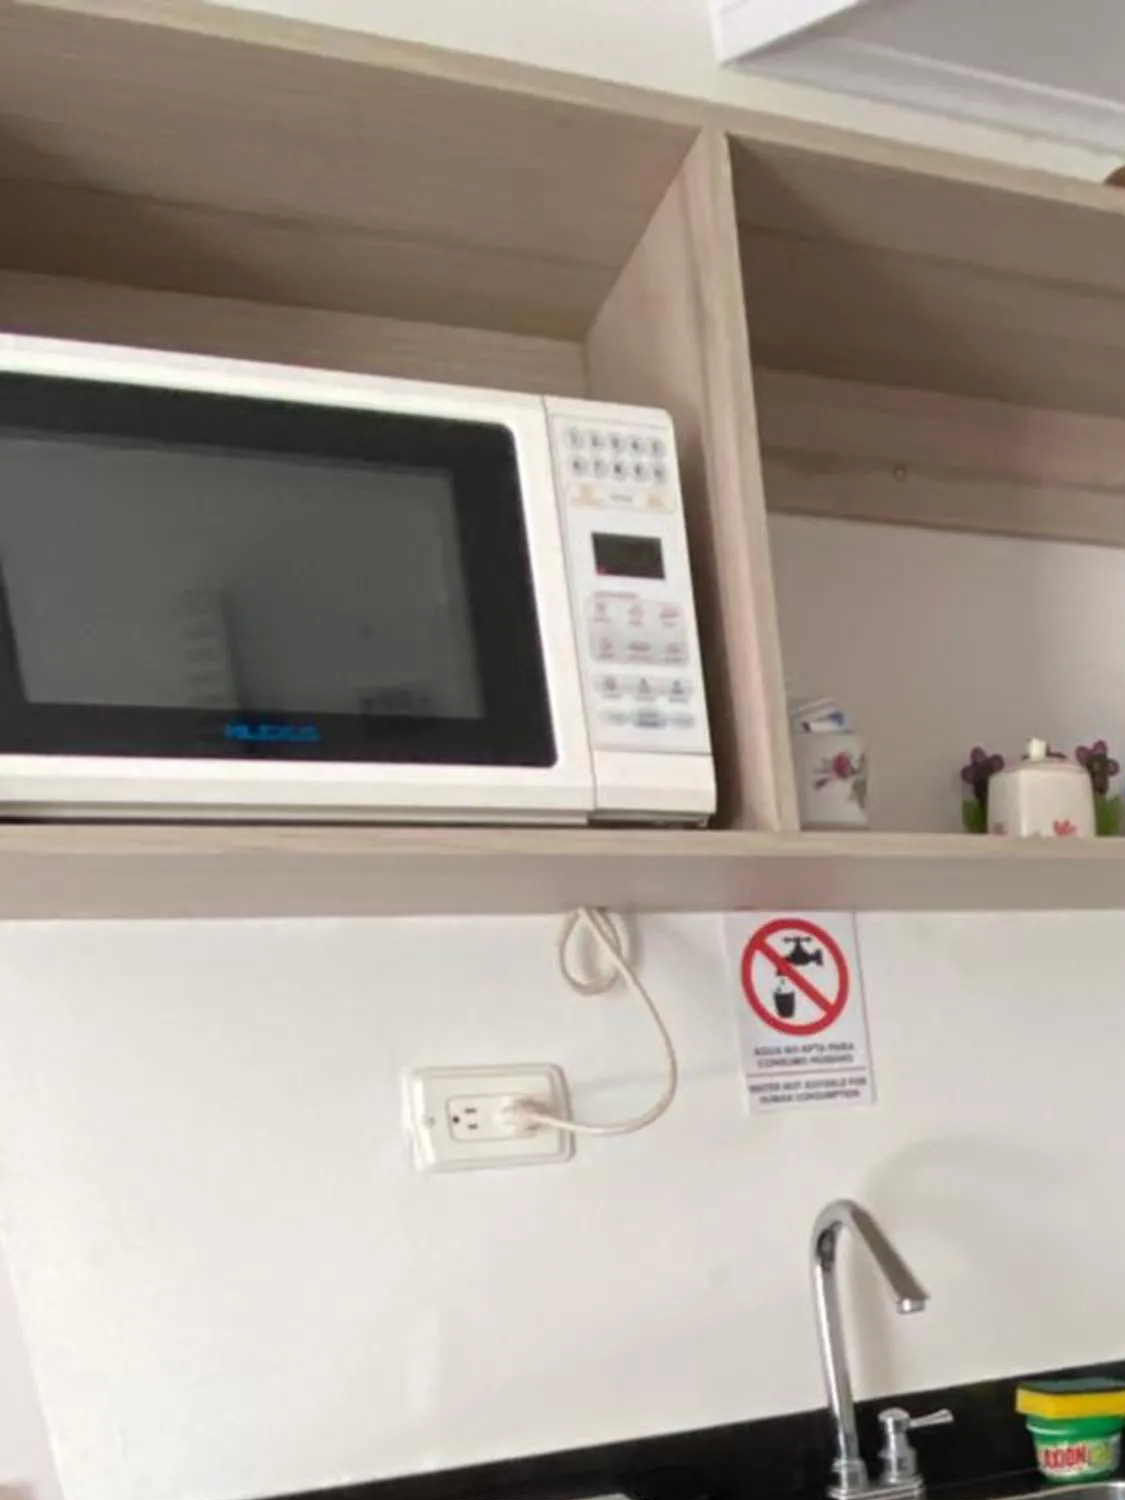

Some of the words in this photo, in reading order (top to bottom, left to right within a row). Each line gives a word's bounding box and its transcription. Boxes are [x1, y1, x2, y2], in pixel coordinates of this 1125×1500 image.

[754, 1045, 782, 1056] AGUA
[784, 1044, 799, 1054] NO
[828, 1042, 854, 1051] PARA
[757, 1056, 807, 1069] CONSUMO
[749, 1082, 780, 1093] WATER
[783, 1081, 801, 1090] NOT
[759, 1094, 792, 1104] HUMAN
[1043, 1444, 1088, 1469] AXION
